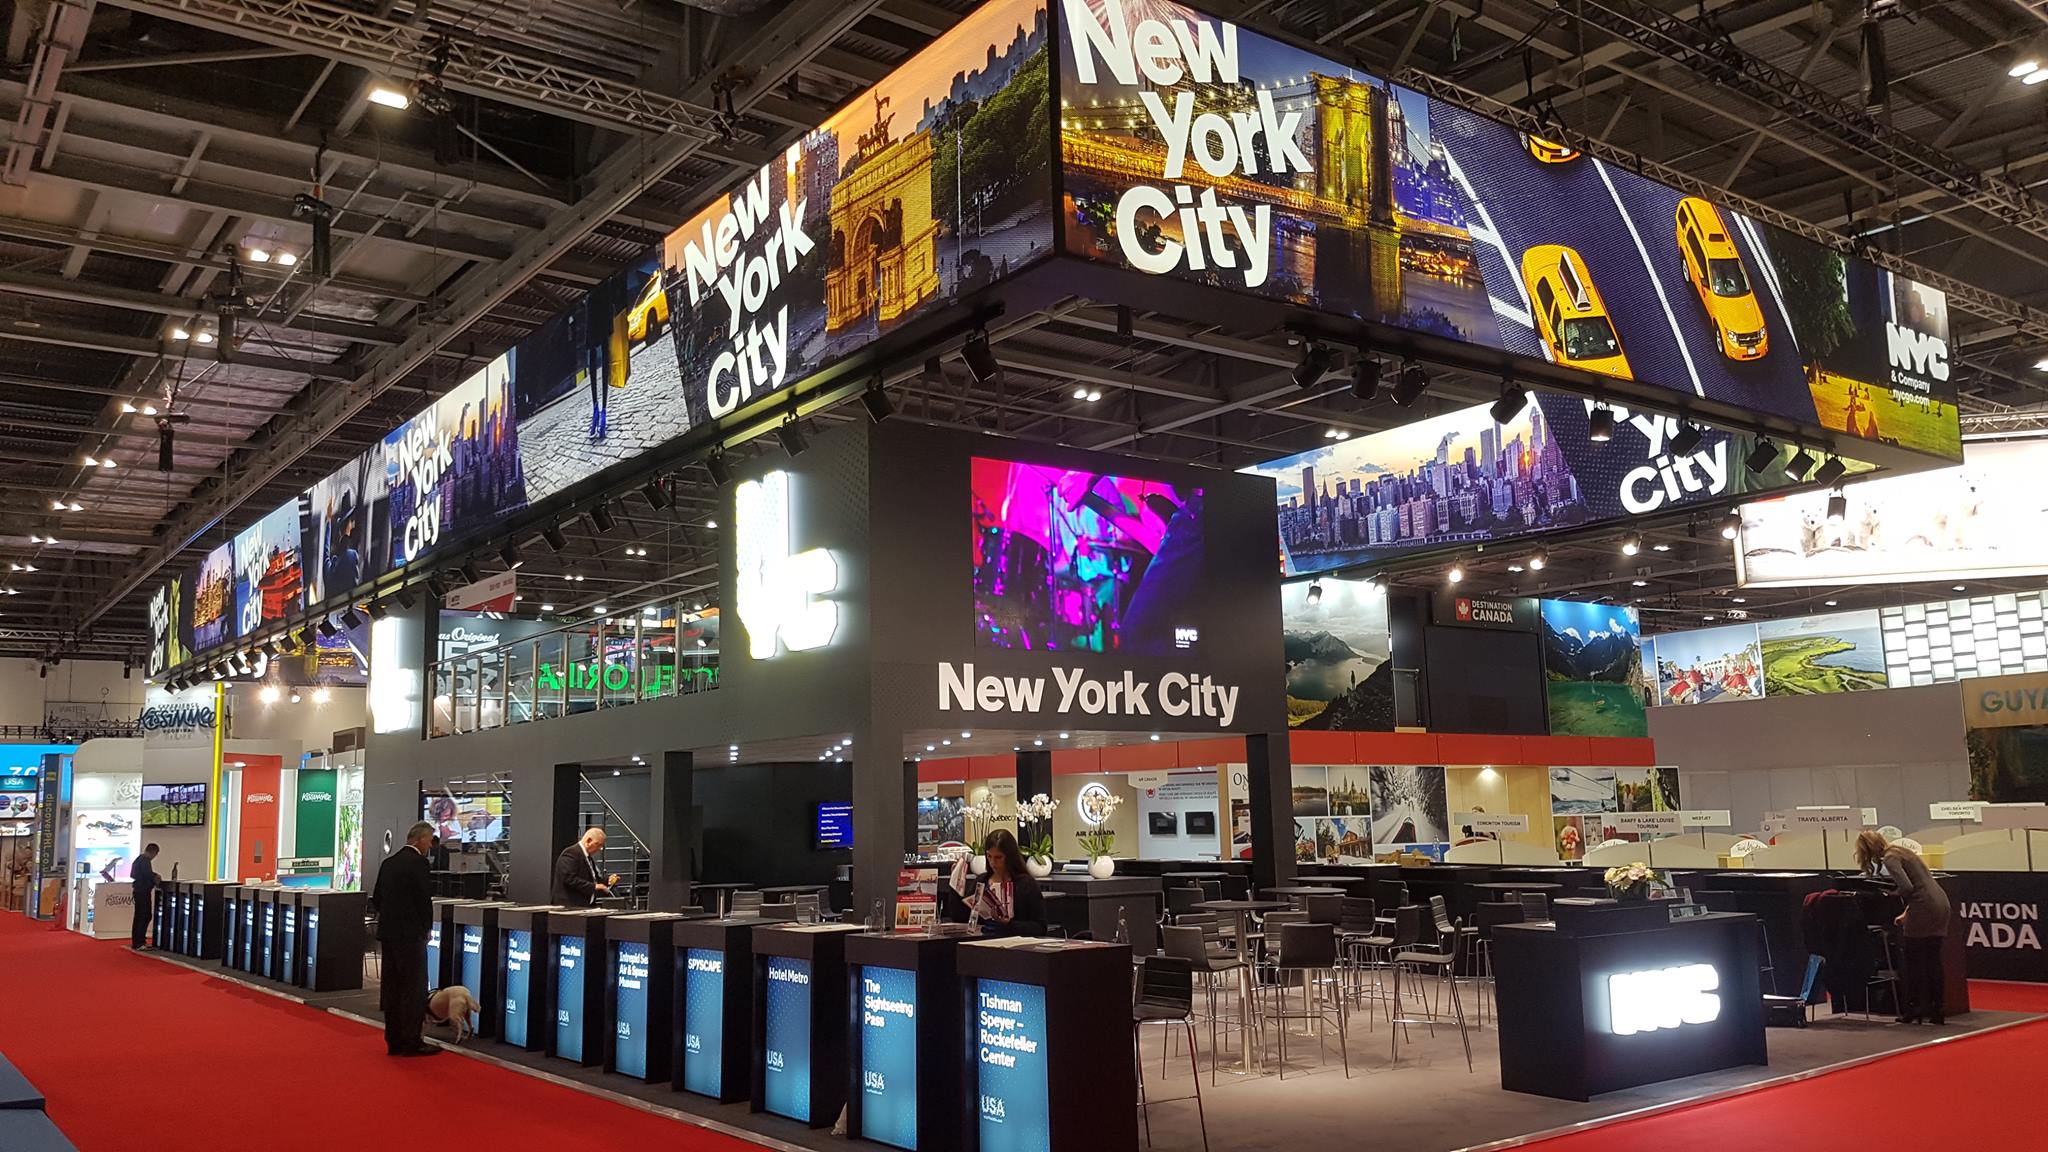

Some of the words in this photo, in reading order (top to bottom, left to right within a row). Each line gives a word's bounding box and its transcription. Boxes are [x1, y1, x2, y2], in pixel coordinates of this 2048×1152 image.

[1062, 0, 1239, 85] New
[1138, 90, 1314, 179] York
[683, 164, 769, 307] New
[1116, 185, 1270, 288] City
[717, 197, 815, 339] York
[707, 305, 788, 419] City
[1886, 321, 1949, 381] NYC
[1891, 370, 1897, 382] &
[1898, 372, 1930, 393] Company
[1893, 389, 1930, 406] nycgo.com
[400, 403, 437, 478] New
[412, 431, 453, 508] York
[1620, 440, 1727, 514] City
[404, 495, 440, 561] City
[241, 520, 263, 576] New
[248, 541, 270, 597] York
[150, 586, 165, 628] New
[242, 589, 263, 635] City
[1471, 600, 1512, 611] DESTINATION
[1472, 609, 1513, 623] CANADA
[154, 602, 169, 645] York
[451, 627, 499, 641] Original
[1175, 628, 1198, 641] NYC
[150, 640, 164, 676] City
[938, 662, 1045, 711] New
[1052, 667, 1151, 715] York
[1159, 672, 1239, 727] City
[4, 778, 24, 786] USA
[619, 963, 627, 975] Air
[632, 965, 648, 978] Space
[688, 958, 722, 973] SPYSCAPE
[769, 966, 788, 981] Hotel
[788, 969, 809, 984] Metro
[865, 979, 881, 994] The
[507, 1000, 516, 1010] USA
[865, 995, 913, 1018] Sightseeing
[980, 993, 1022, 1013] Tishman
[559, 1010, 569, 1022] USA
[865, 1011, 885, 1027] Pass
[980, 1011, 1016, 1031] Speyer
[618, 1022, 630, 1035] USA
[687, 1034, 700, 1049] USA
[980, 1029, 1037, 1053] Rockefeller
[767, 1049, 784, 1067] USA
[980, 1047, 1016, 1068] Center
[865, 1070, 885, 1089] USA
[981, 1095, 1005, 1118] USA
